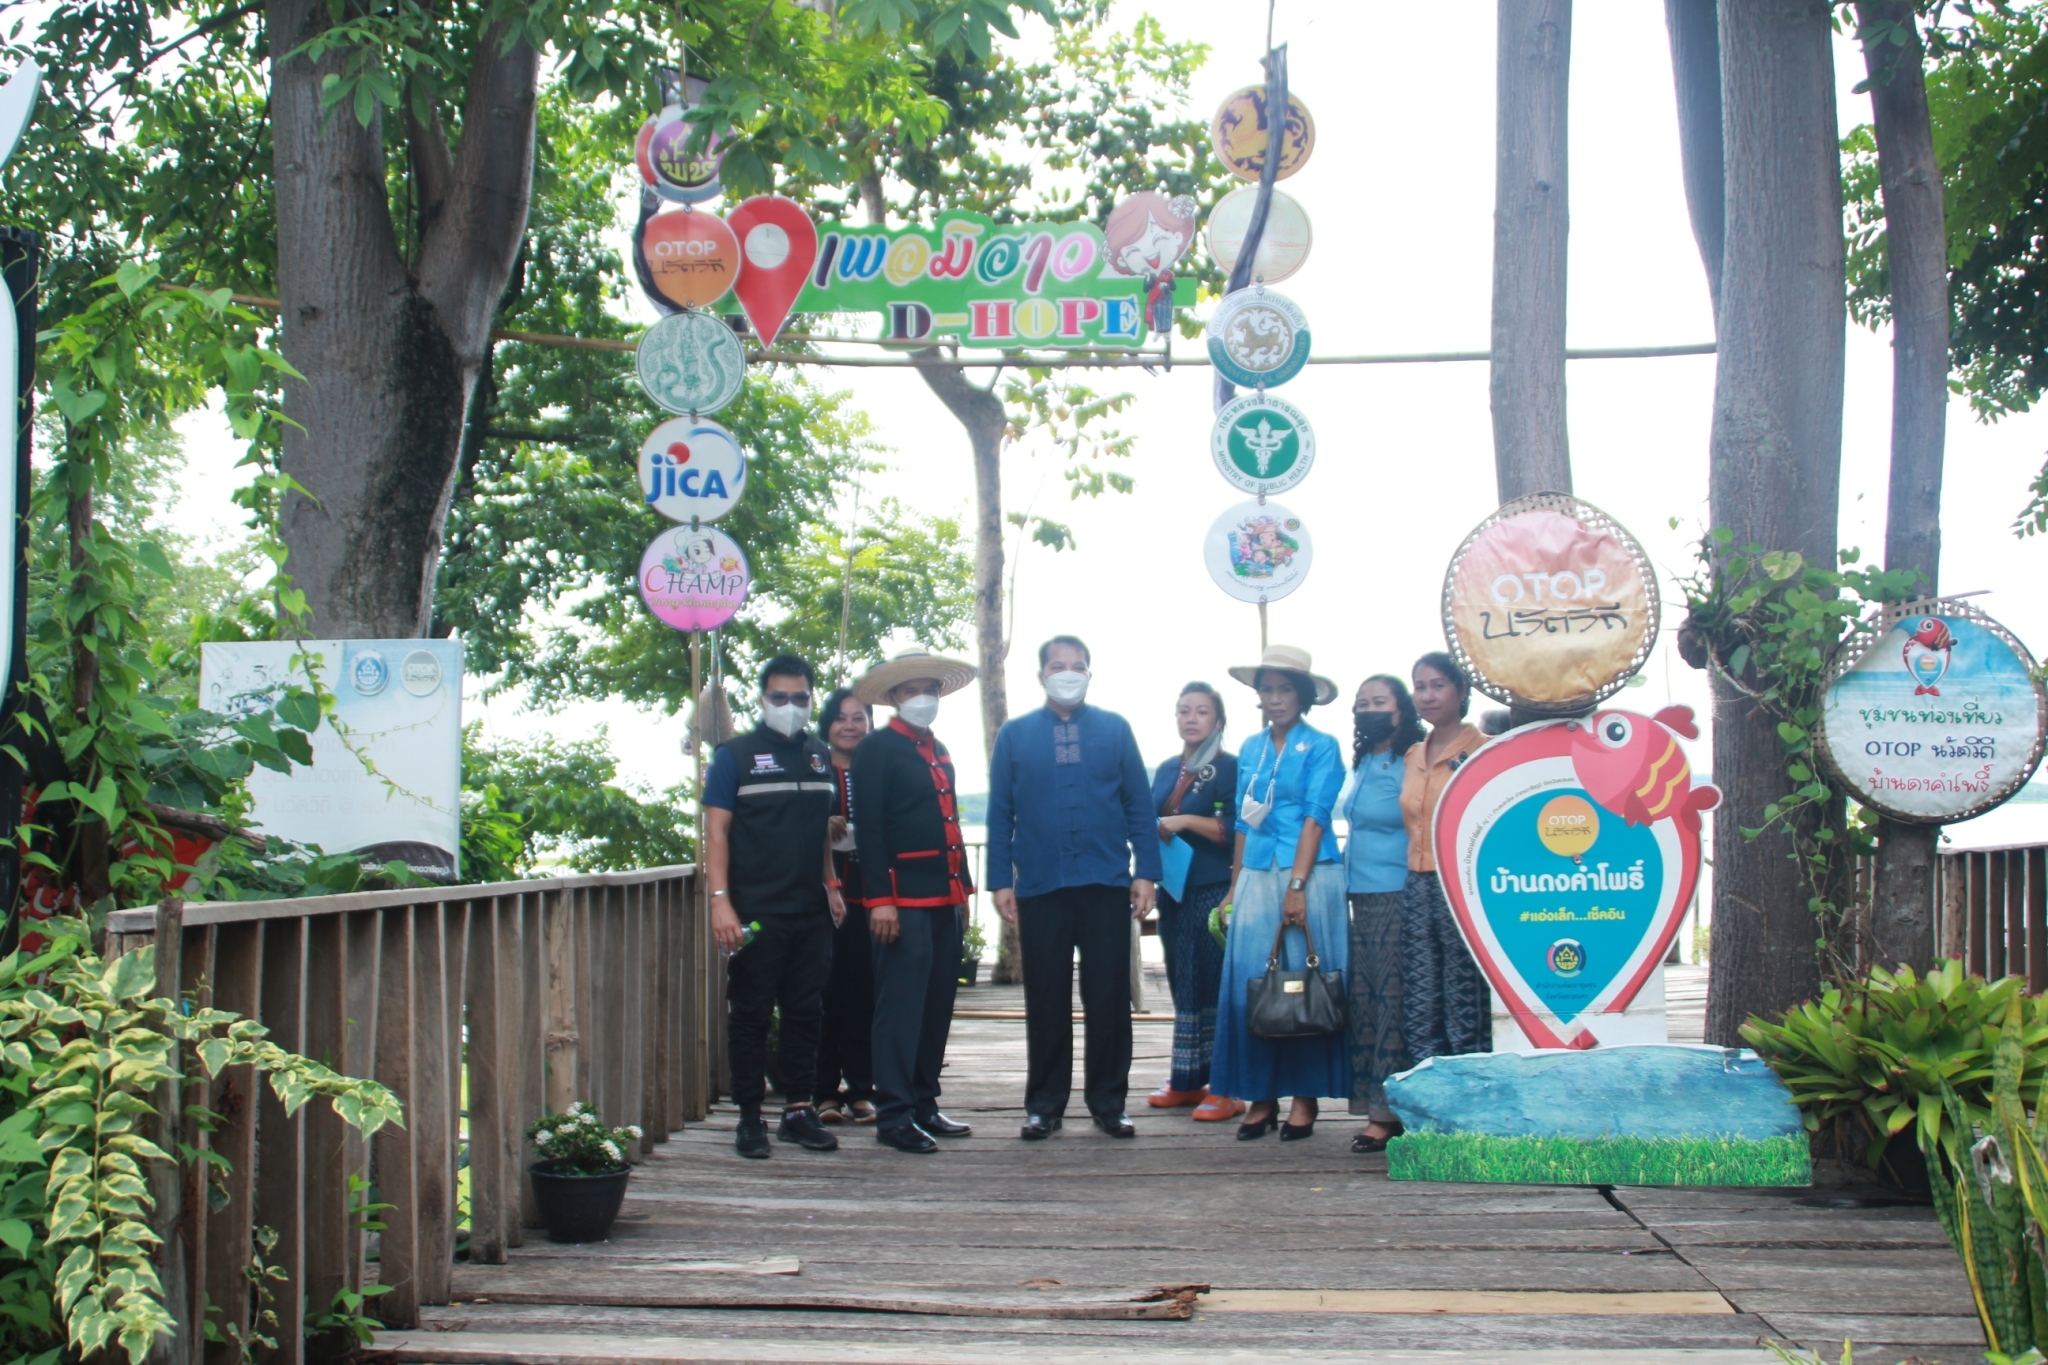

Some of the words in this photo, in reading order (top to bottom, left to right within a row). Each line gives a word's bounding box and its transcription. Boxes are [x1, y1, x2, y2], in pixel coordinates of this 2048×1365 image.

[655, 240, 717, 257] OTOP
[890, 295, 1140, 339] D-HOPE
[1217, 450, 1243, 482] MINISTRY
[1244, 479, 1256, 488] OF
[1259, 478, 1287, 490] PUBLIC
[1288, 454, 1310, 481] HEALTH
[644, 564, 744, 597] CHAMP
[1491, 568, 1606, 604] OTOP
[406, 663, 435, 673] OTOP
[1859, 696, 2003, 729] ชุมชนท่องเที่ยว
[1865, 740, 1921, 757] OTOP
[1931, 735, 1995, 759] นวัตวิถี
[1868, 764, 1994, 792] บ้านดงคำโพธิ์
[1549, 815, 1586, 825] OTOP
[1491, 859, 1645, 894] บ้านดงคำโพธิ์
